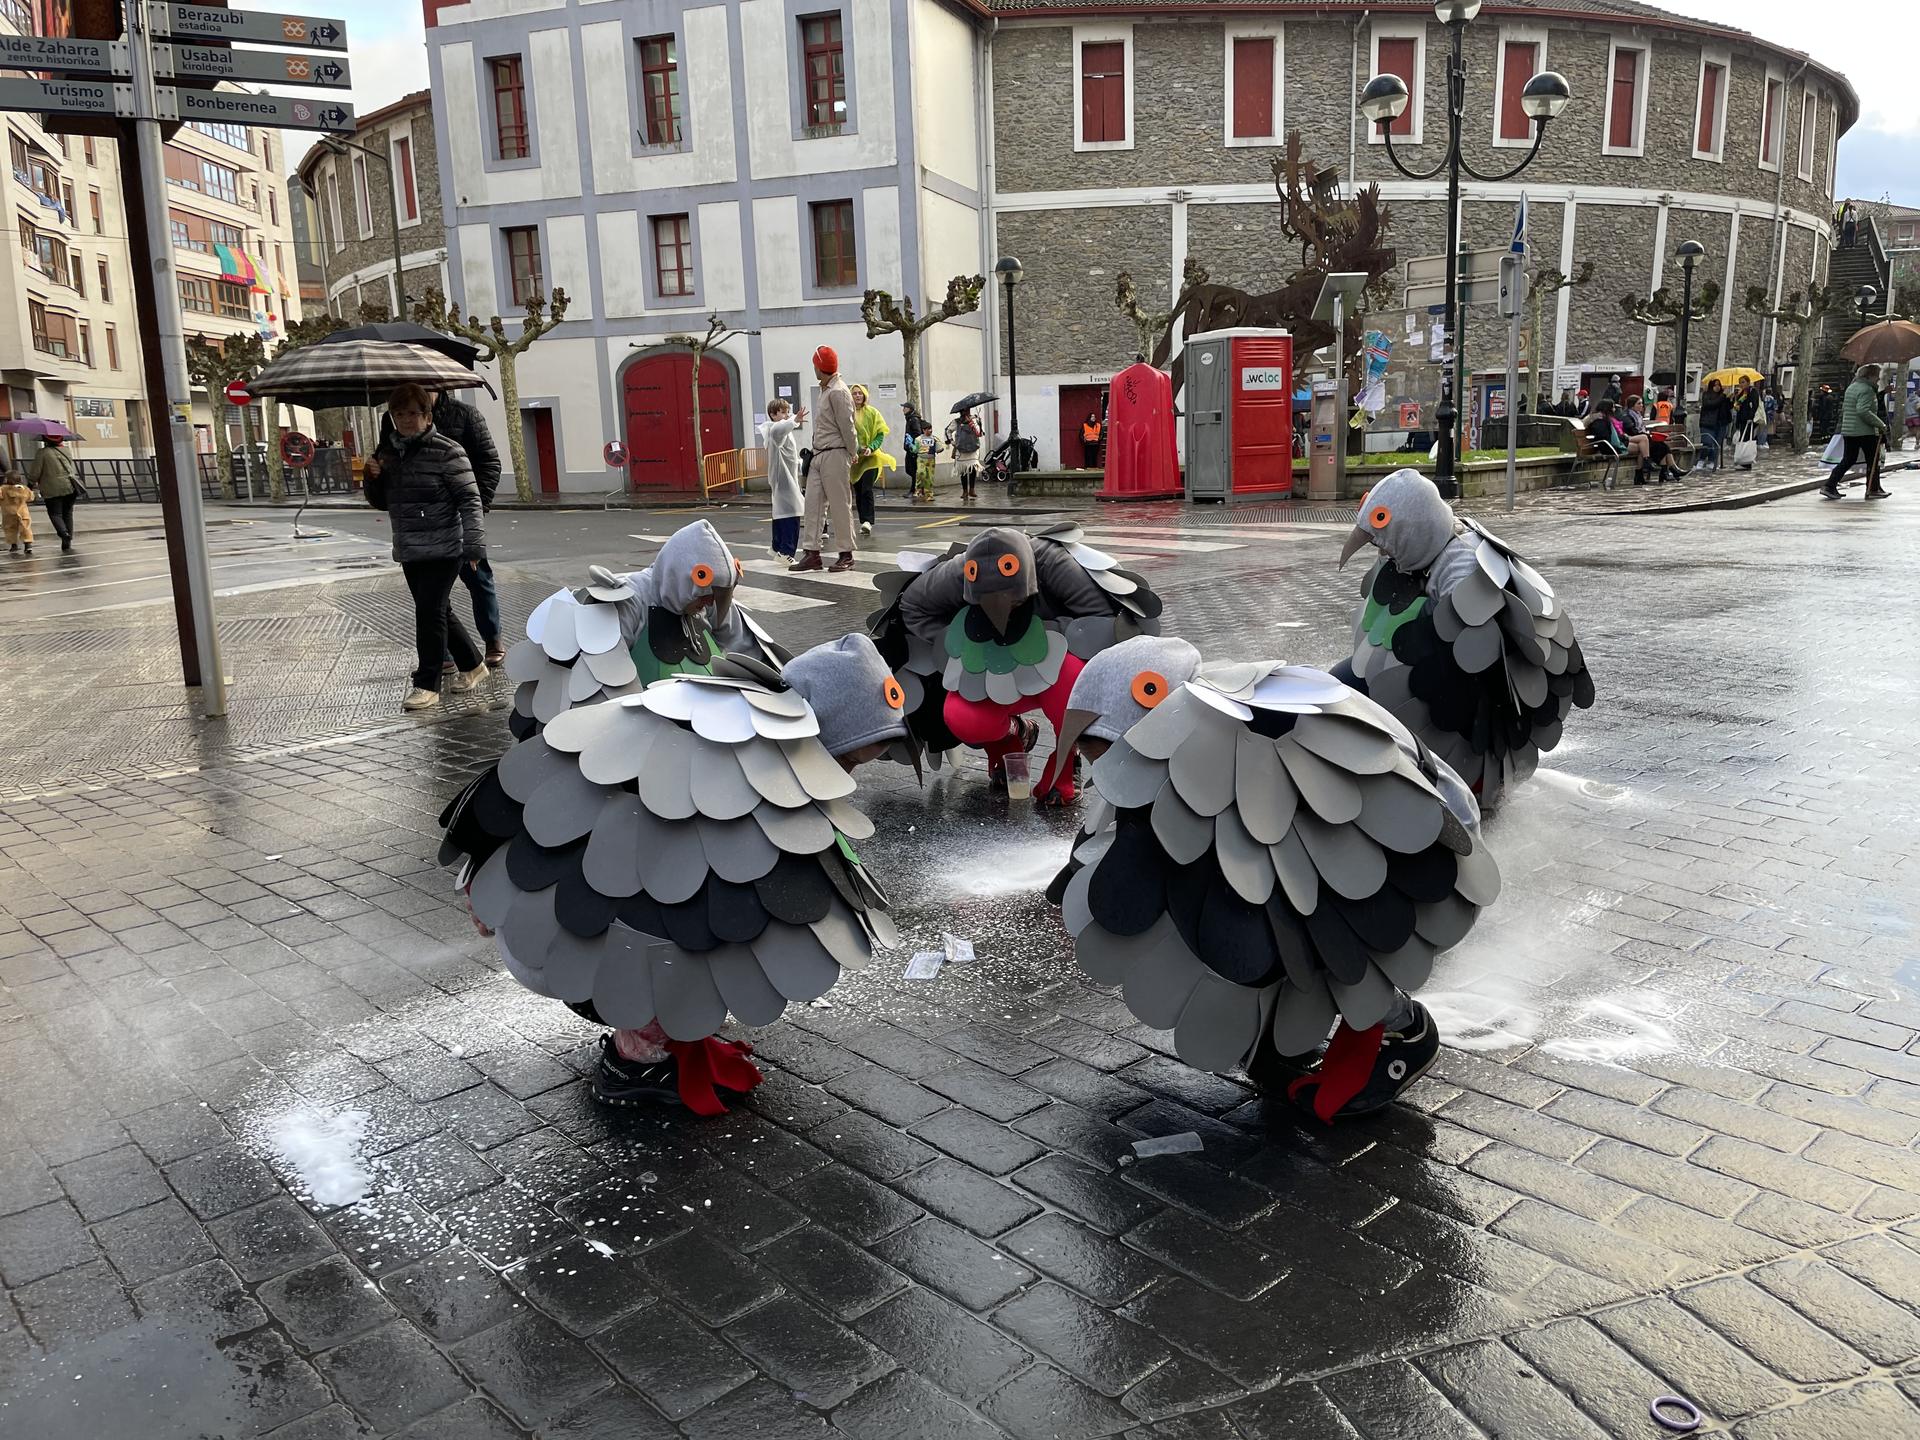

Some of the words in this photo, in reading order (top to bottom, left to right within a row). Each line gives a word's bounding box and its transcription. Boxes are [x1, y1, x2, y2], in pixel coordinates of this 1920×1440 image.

[178, 8, 244, 24] Berazubi
[178, 22, 222, 32] estadioa
[36, 41, 99, 56] Zaharra
[7, 54, 43, 63] zentro
[46, 54, 100, 66] historikoa
[181, 49, 232, 63] Usabal
[182, 62, 233, 74] kiroldegia
[40, 83, 103, 98] Turismo
[61, 97, 105, 109] bulegoa
[186, 96, 277, 114] Bonberenea
